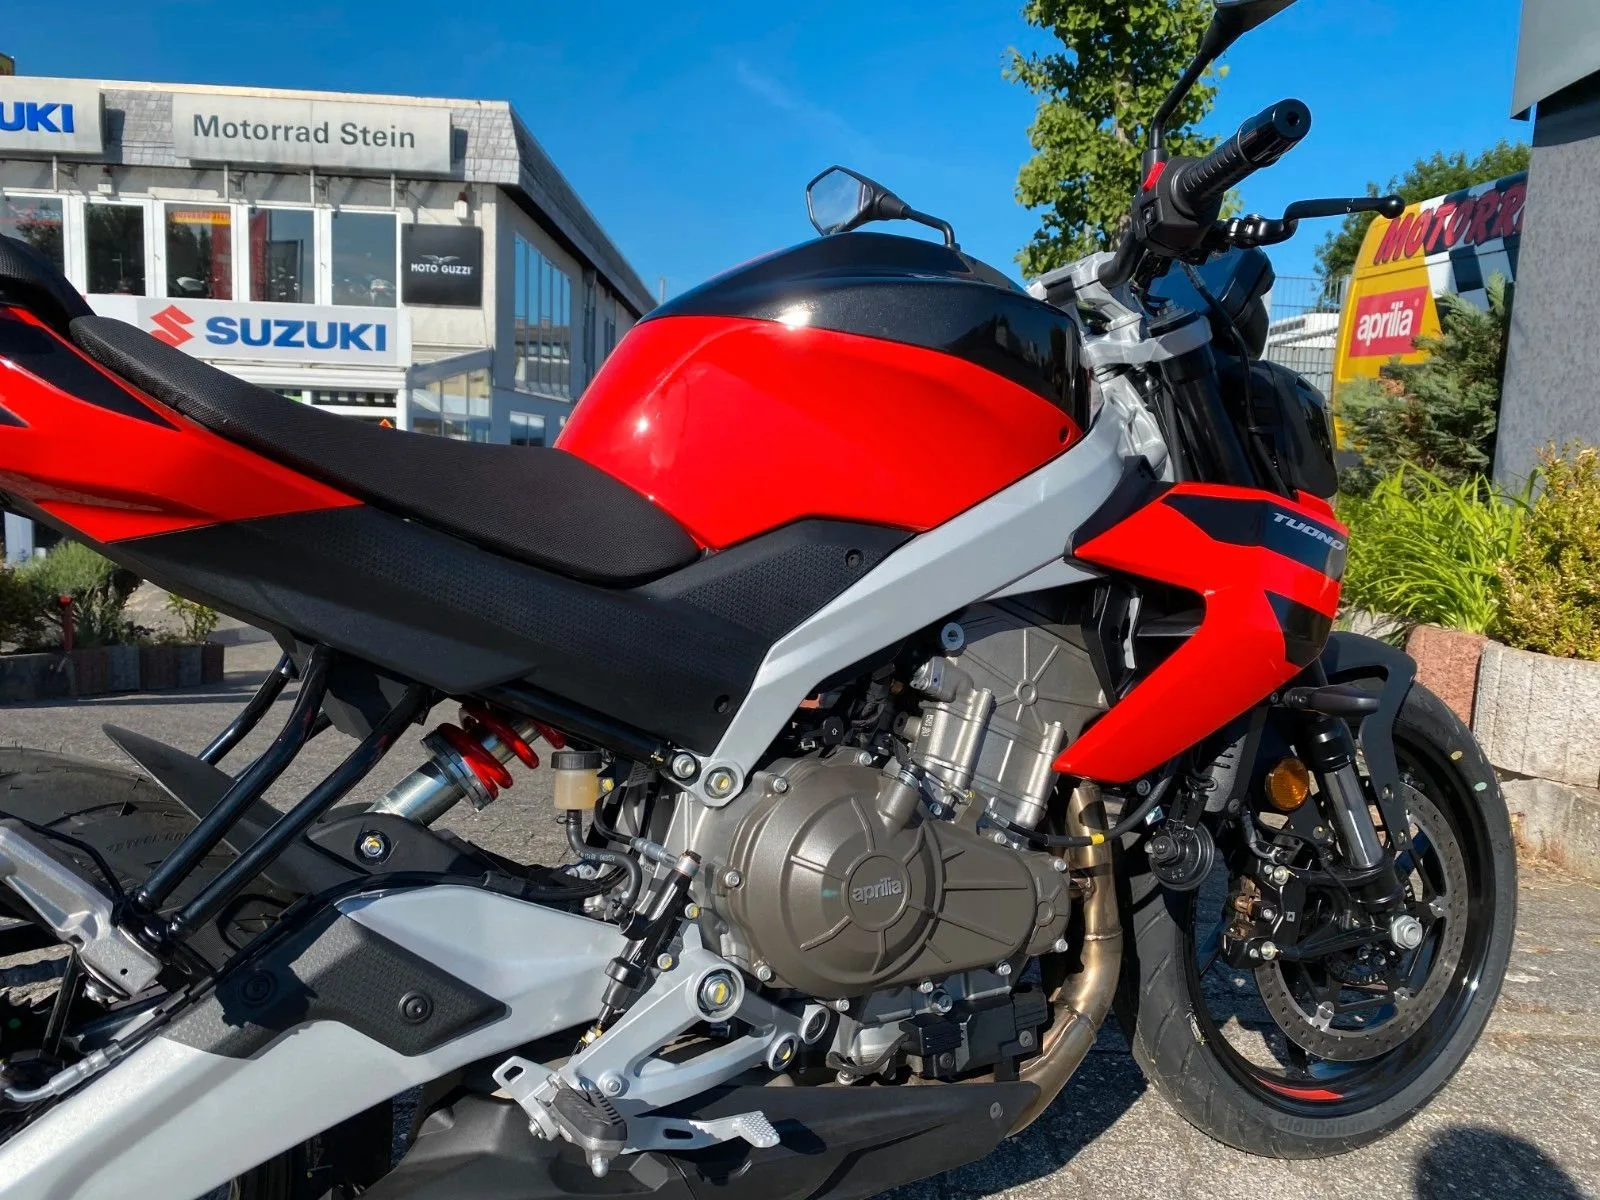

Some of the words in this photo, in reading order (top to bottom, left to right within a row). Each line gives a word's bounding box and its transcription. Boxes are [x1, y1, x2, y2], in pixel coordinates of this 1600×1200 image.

[193, 114, 329, 144] Motorrad
[340, 122, 415, 148] Stein
[1373, 181, 1526, 265] MOTORR
[411, 263, 438, 273] MOTO
[441, 265, 471, 275] GUZZI
[205, 316, 386, 351] SUZUKI
[1357, 301, 1413, 347] aprilia
[1273, 512, 1346, 551] TUONO
[852, 877, 902, 904] aprilia
